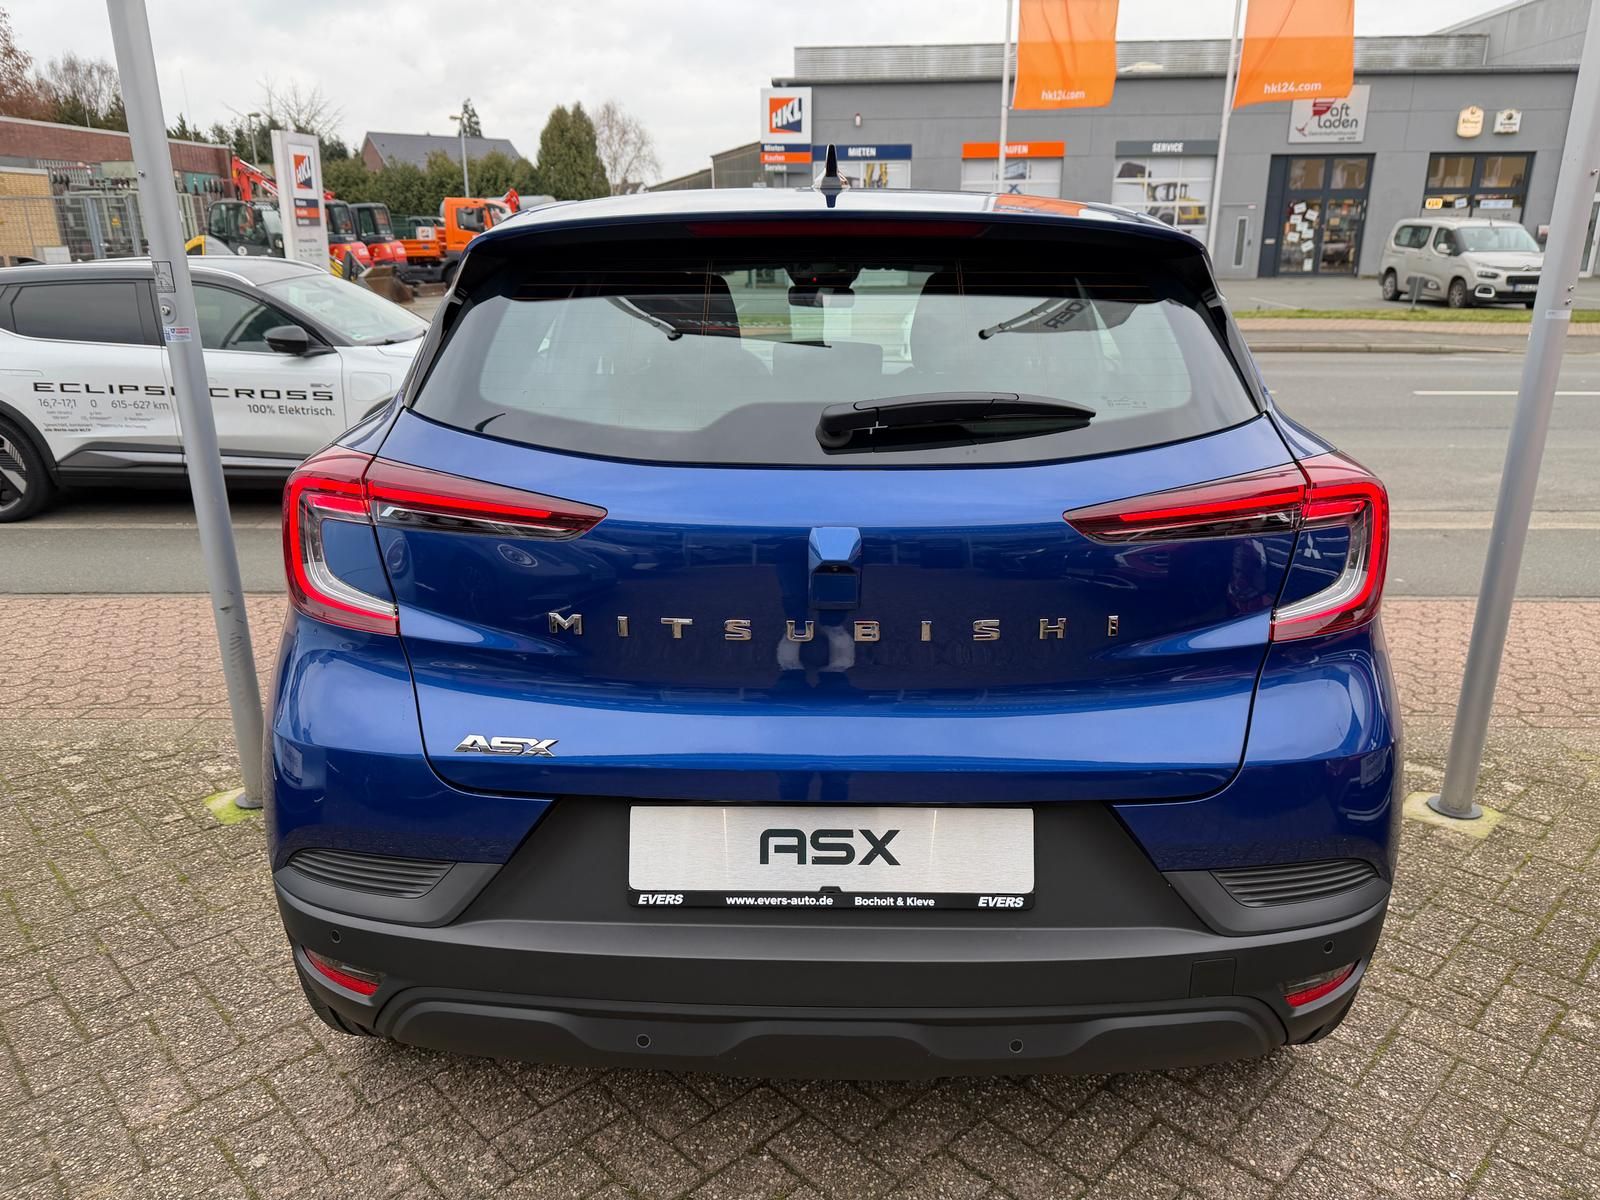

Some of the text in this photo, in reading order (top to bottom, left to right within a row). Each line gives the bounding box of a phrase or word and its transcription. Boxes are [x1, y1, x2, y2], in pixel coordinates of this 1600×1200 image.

[1264, 82, 1322, 95] hkl24.com
[772, 97, 801, 128] HKL
[847, 147, 877, 157] MIETEN
[1004, 144, 1029, 154] AUFEN
[1152, 142, 1184, 153] SERVICE
[33, 382, 333, 401] ECLIPS CROSS
[153, 401, 169, 410] km
[247, 404, 335, 416] 100% Elektrisch.
[548, 613, 1119, 643] MITSUBISHI
[454, 734, 559, 758] ASX
[760, 829, 901, 866] ASX
[638, 894, 1025, 908] EVERS www.evers-auto.de Bocholt & Kleve EVERS
